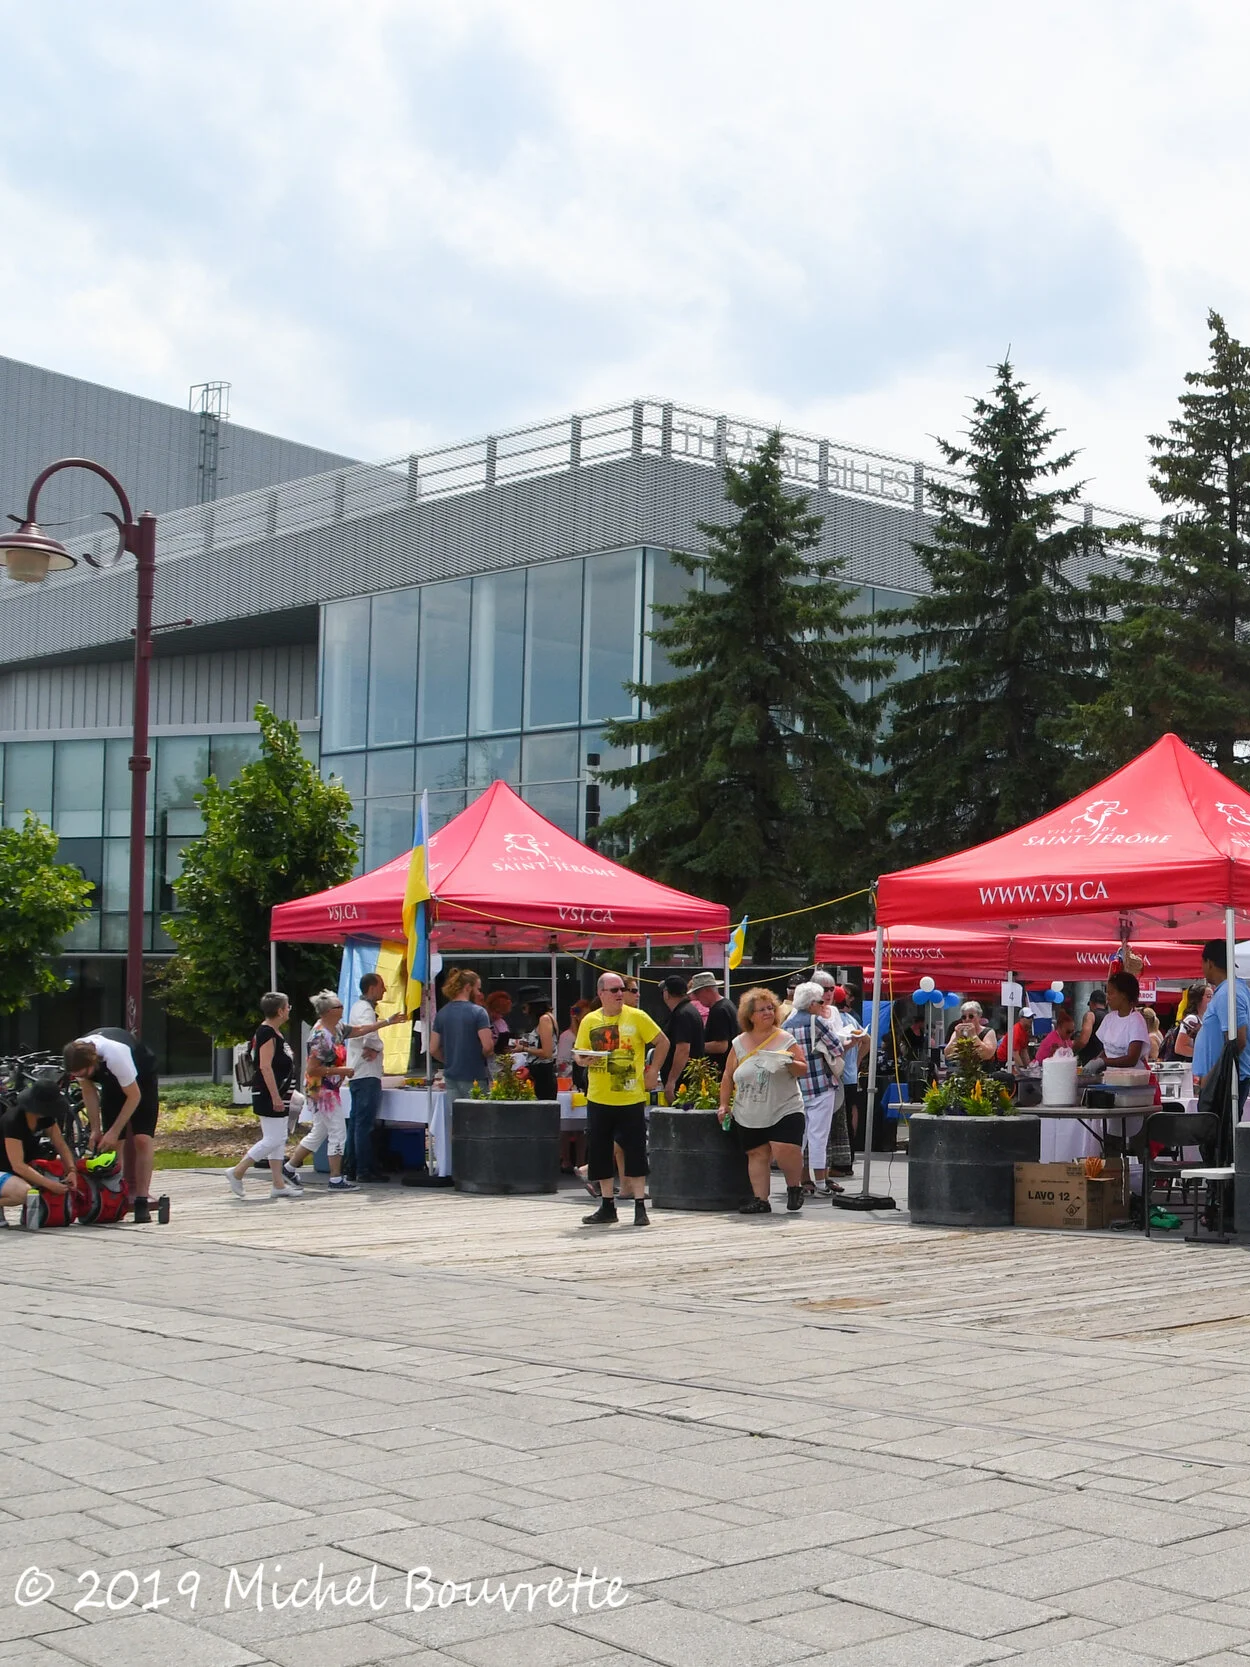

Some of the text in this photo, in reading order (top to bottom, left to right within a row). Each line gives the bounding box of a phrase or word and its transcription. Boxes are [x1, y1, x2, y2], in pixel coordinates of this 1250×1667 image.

[825, 454, 910, 499] GILLES
[1022, 832, 1173, 846] SAINT-JÉRÔME
[978, 880, 1110, 907] WWW.VSJ.CA
[327, 904, 359, 924] VSJ.CA
[558, 906, 616, 925] VSJ.CA
[1008, 991, 1015, 1001] 4
[1028, 1190, 1071, 1201] LAVO 12
